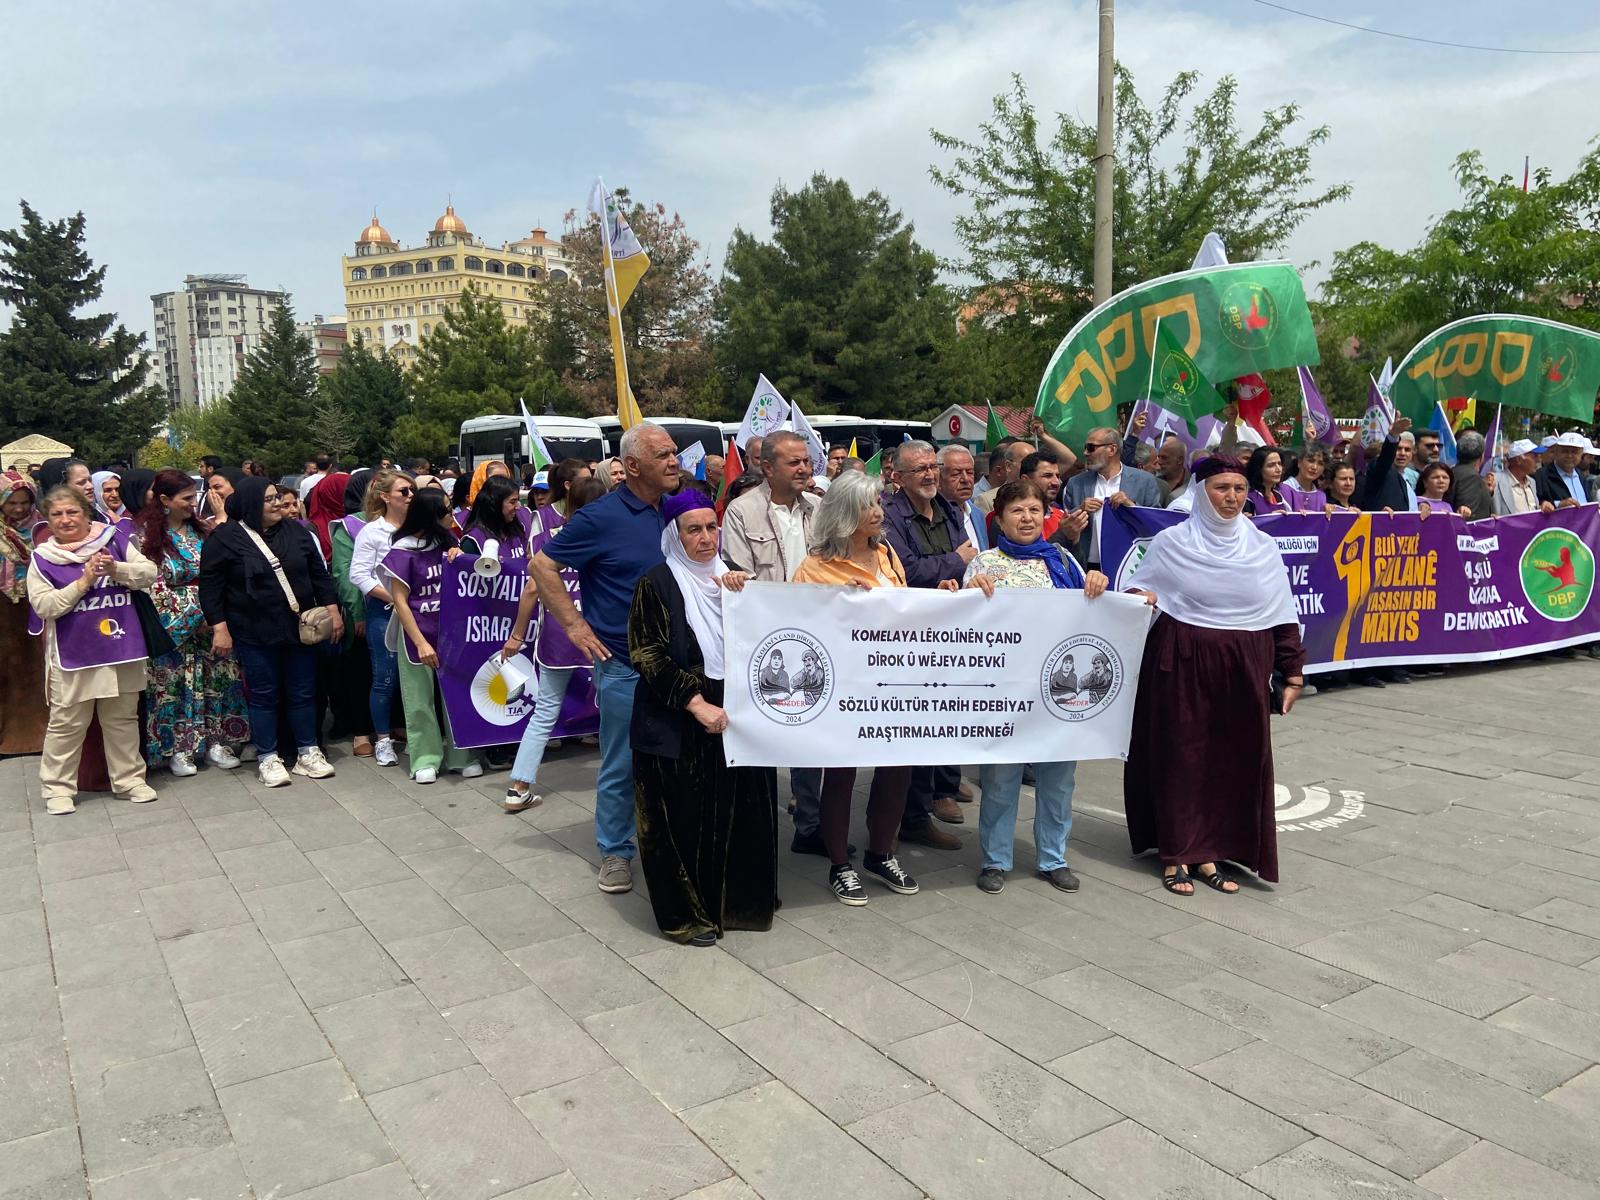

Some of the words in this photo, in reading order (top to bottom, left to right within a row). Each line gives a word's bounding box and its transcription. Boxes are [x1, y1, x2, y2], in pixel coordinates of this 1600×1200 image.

[1292, 565, 1310, 585] VE
[1375, 550, 1438, 588] GULANÊ
[1367, 592, 1412, 614] YAŞASIN
[1412, 587, 1437, 610] BİR
[1547, 591, 1576, 607] DBP
[466, 615, 512, 643] ISRAR
[851, 629, 918, 643] KOMELAYA
[920, 627, 983, 644] LÊKOLÎNÊN
[985, 631, 1022, 647] ÇAND
[1360, 611, 1420, 643] MAYIS
[867, 651, 904, 667] DÎROK
[907, 651, 916, 667] Û
[918, 651, 966, 668] WÊJEYA
[968, 653, 1006, 668] DEVKÎ
[507, 706, 524, 715] TJA
[838, 696, 879, 712] SÖZLÜ
[881, 696, 929, 712] KÜLTÜR
[931, 696, 970, 712] TARİH
[972, 697, 1035, 713] EDEBİYAT
[785, 715, 802, 723] 2024
[857, 725, 959, 743] ARAŞTIRMALARI
[960, 722, 1015, 738] DERNEĞİ
